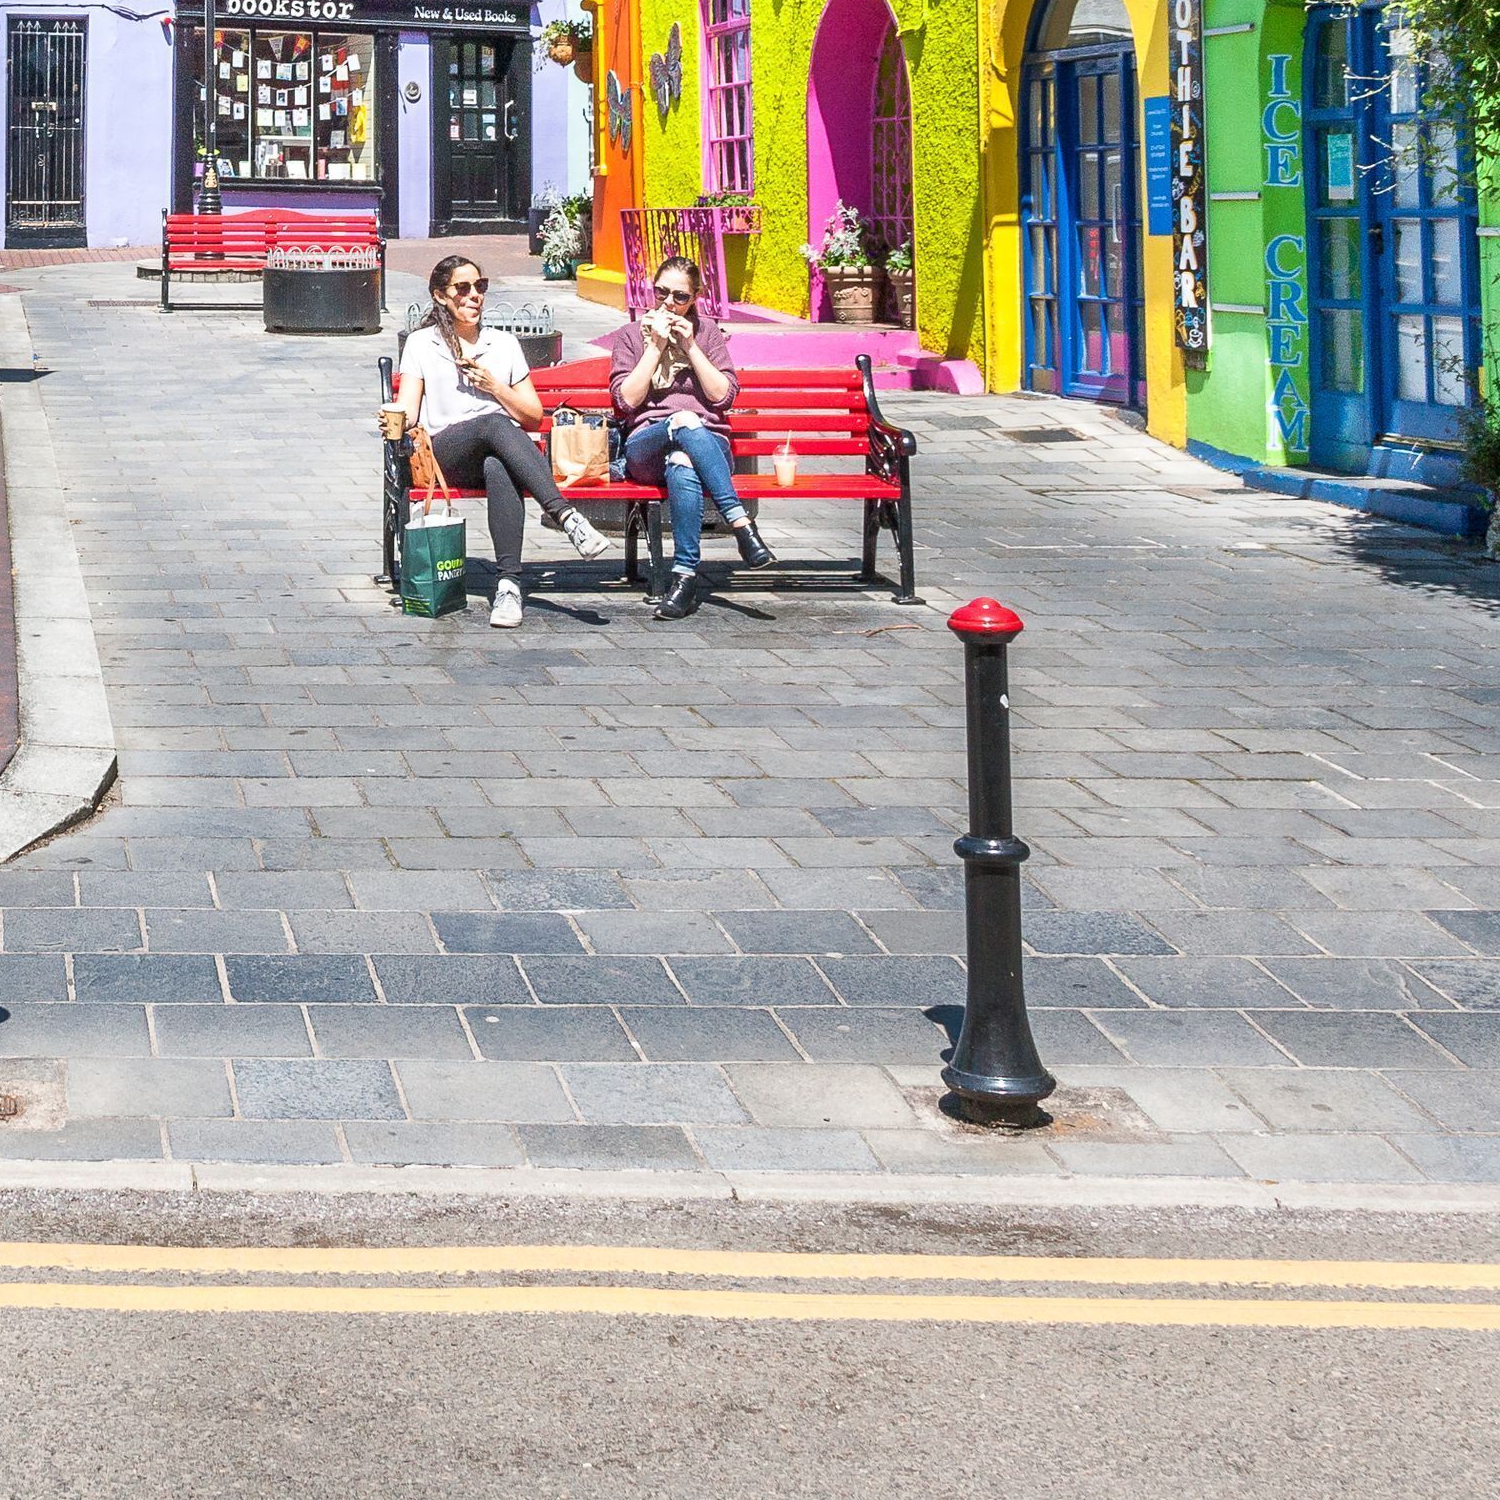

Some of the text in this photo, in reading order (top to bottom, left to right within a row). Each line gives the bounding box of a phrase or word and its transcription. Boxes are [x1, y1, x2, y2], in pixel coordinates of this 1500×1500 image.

[414, 5, 517, 23] New & Used Books
[1178, 195, 1199, 309] BAR
[1261, 53, 1310, 453] ICE CREAM
